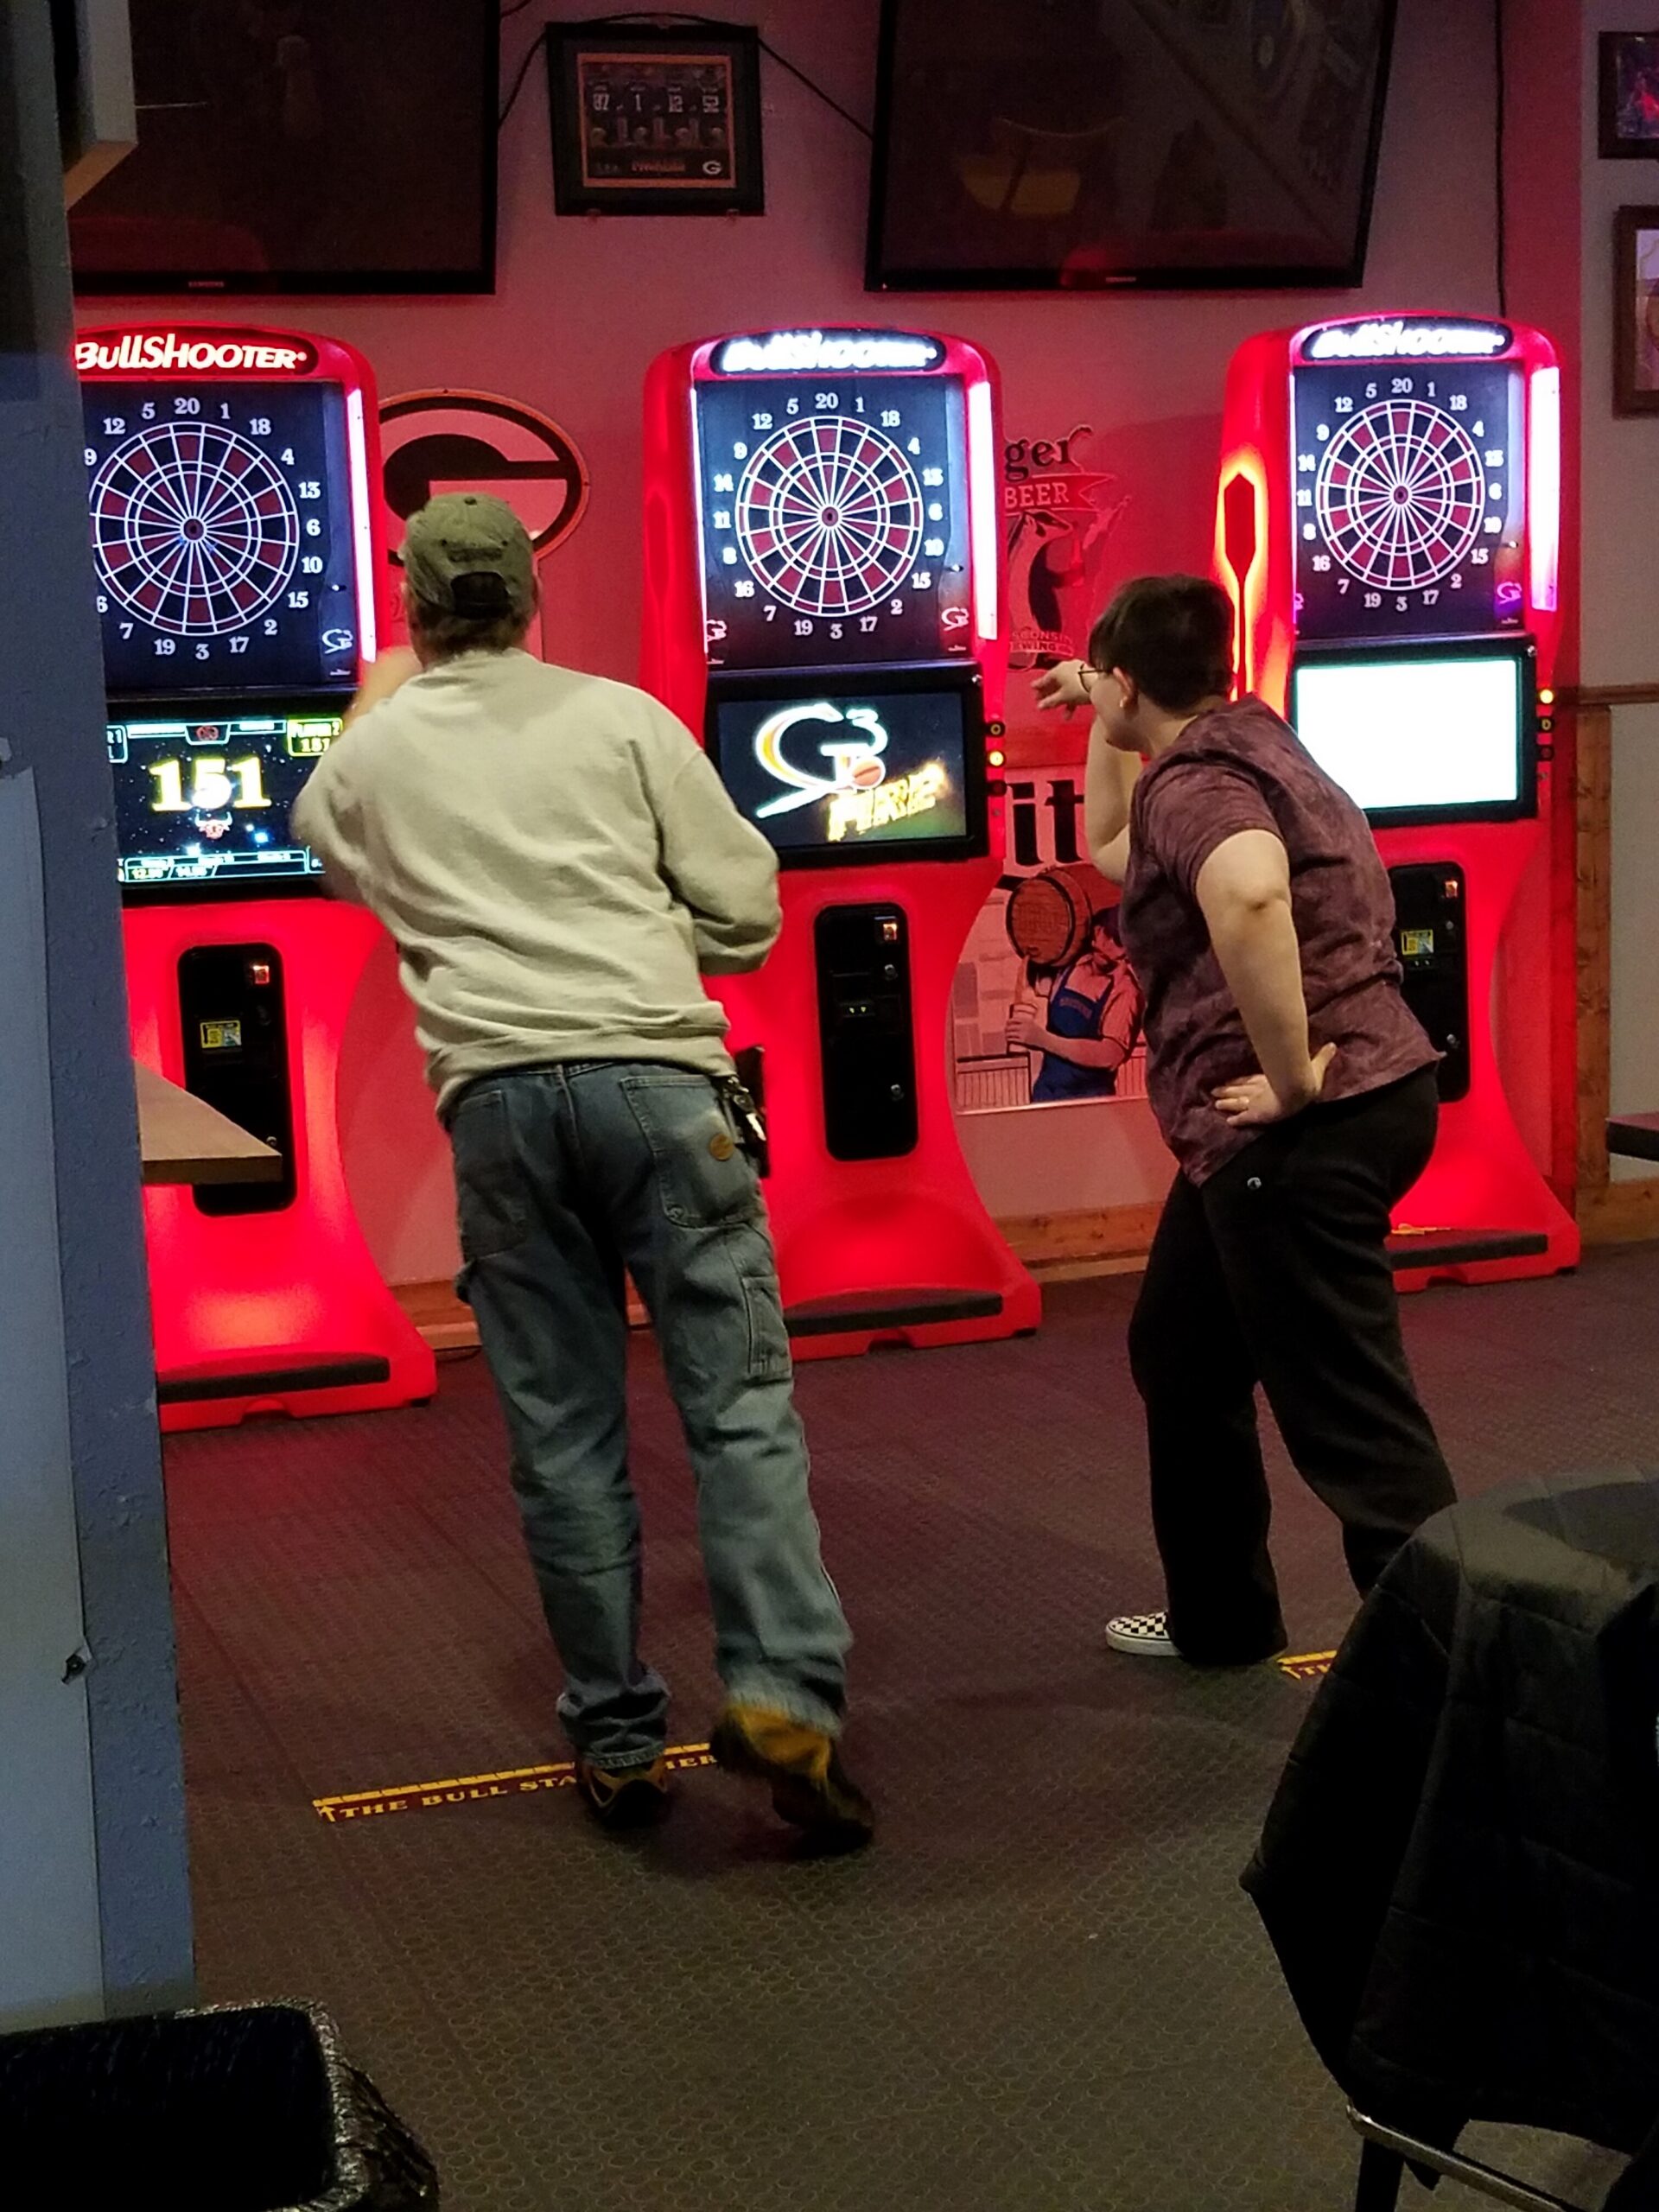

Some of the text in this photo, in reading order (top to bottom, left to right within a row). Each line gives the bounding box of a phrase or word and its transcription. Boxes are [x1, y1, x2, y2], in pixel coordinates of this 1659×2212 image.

[702, 160, 722, 175] G
[1365, 382, 1377, 398] 5
[1391, 378, 1413, 394] 20
[1427, 381, 1436, 397] 1
[174, 397, 200, 415] 20
[786, 397, 799, 415] 5
[815, 392, 839, 410] 20
[855, 397, 865, 413] 1
[1334, 397, 1353, 413] 12
[141, 402, 156, 420] 5
[220, 403, 231, 420] 1
[103, 417, 126, 435] 12
[249, 417, 271, 435] 18
[752, 413, 773, 430] 12
[1471, 420, 1484, 437] 4
[907, 436, 920, 455] 4
[1005, 426, 1093, 482] ger
[84, 448, 98, 466] 9
[280, 448, 295, 466] 4
[298, 481, 321, 499] 13
[1005, 482, 1070, 509] BEER
[306, 518, 321, 537] 6
[713, 511, 732, 529] 11
[1312, 555, 1331, 571] 16
[1471, 548, 1489, 564] 15
[301, 556, 323, 574] 10
[911, 571, 931, 589] 15
[1338, 578, 1350, 594] 7
[1450, 573, 1462, 589] 2
[734, 580, 755, 598] 16
[1422, 589, 1440, 605] 17
[96, 595, 109, 613] 6
[287, 591, 309, 608] 15
[890, 598, 903, 615] 2
[1363, 592, 1382, 607] 19
[763, 605, 777, 621] 7
[119, 622, 134, 639] 7
[264, 619, 278, 635] 2
[794, 619, 813, 636] 19
[830, 623, 843, 639] 3
[859, 615, 878, 632] 17
[229, 636, 250, 653] 17
[1012, 630, 1073, 645] SCONSIN
[154, 639, 176, 656] 19
[195, 643, 210, 660] 3
[149, 757, 272, 811] 151
[1007, 779, 1085, 867] it
[340, 1800, 408, 1818] THE
[422, 1786, 508, 1806] BULL
[519, 1776, 577, 1792] STA
